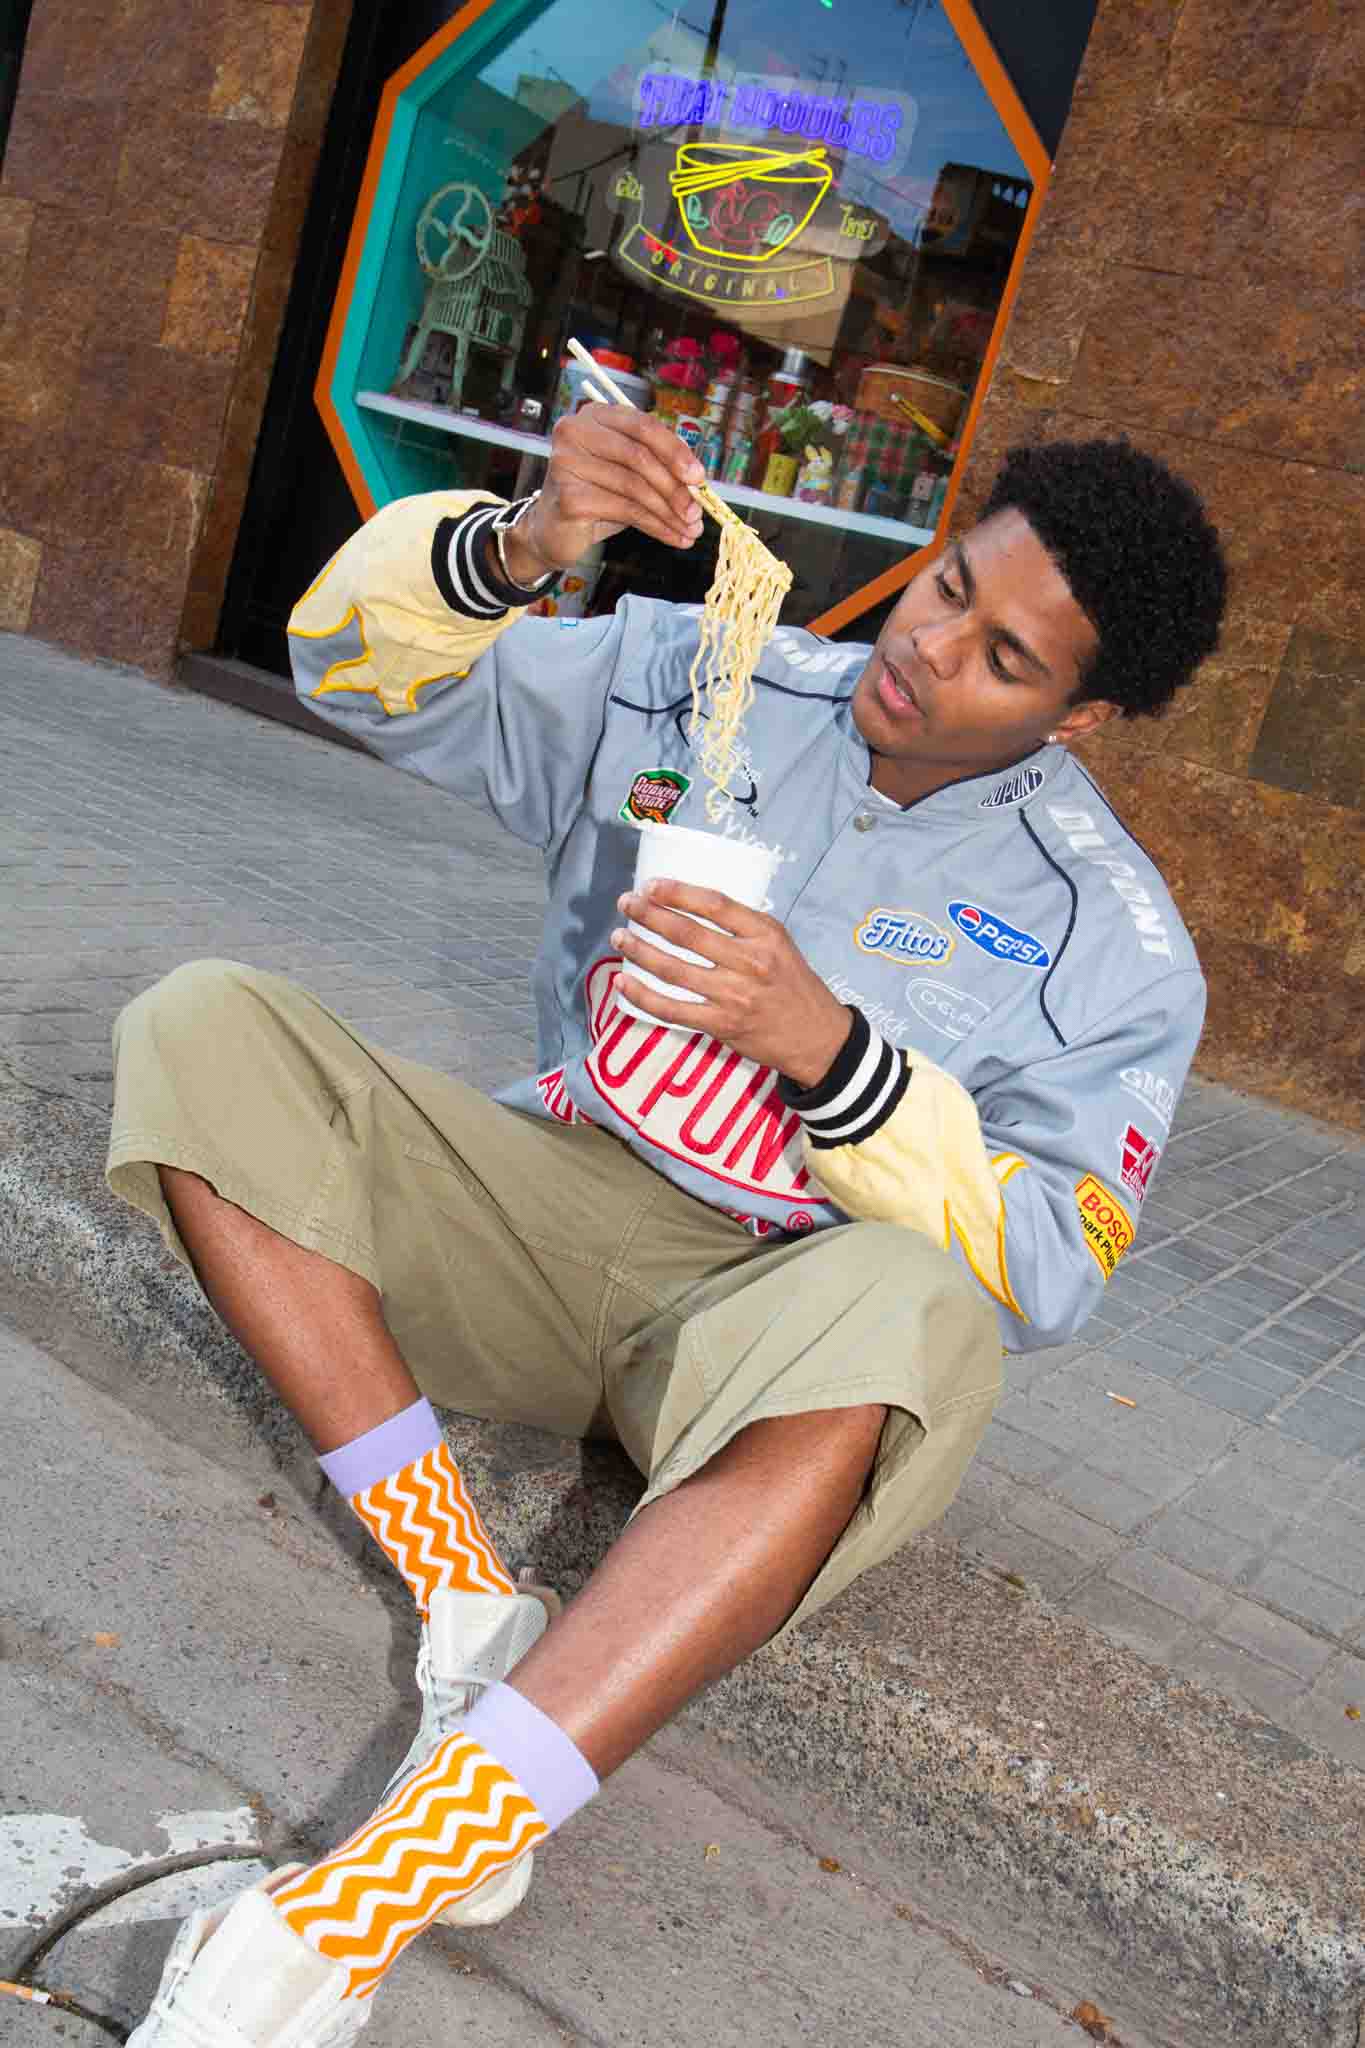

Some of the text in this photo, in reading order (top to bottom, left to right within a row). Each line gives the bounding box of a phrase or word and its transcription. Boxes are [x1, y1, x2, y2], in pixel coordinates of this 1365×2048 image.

[632, 775, 681, 802] QUAKER
[635, 793, 669, 809] STATE
[981, 767, 1041, 806] DUPONT
[863, 914, 949, 958] Fritos
[975, 921, 1047, 964] PEPSI
